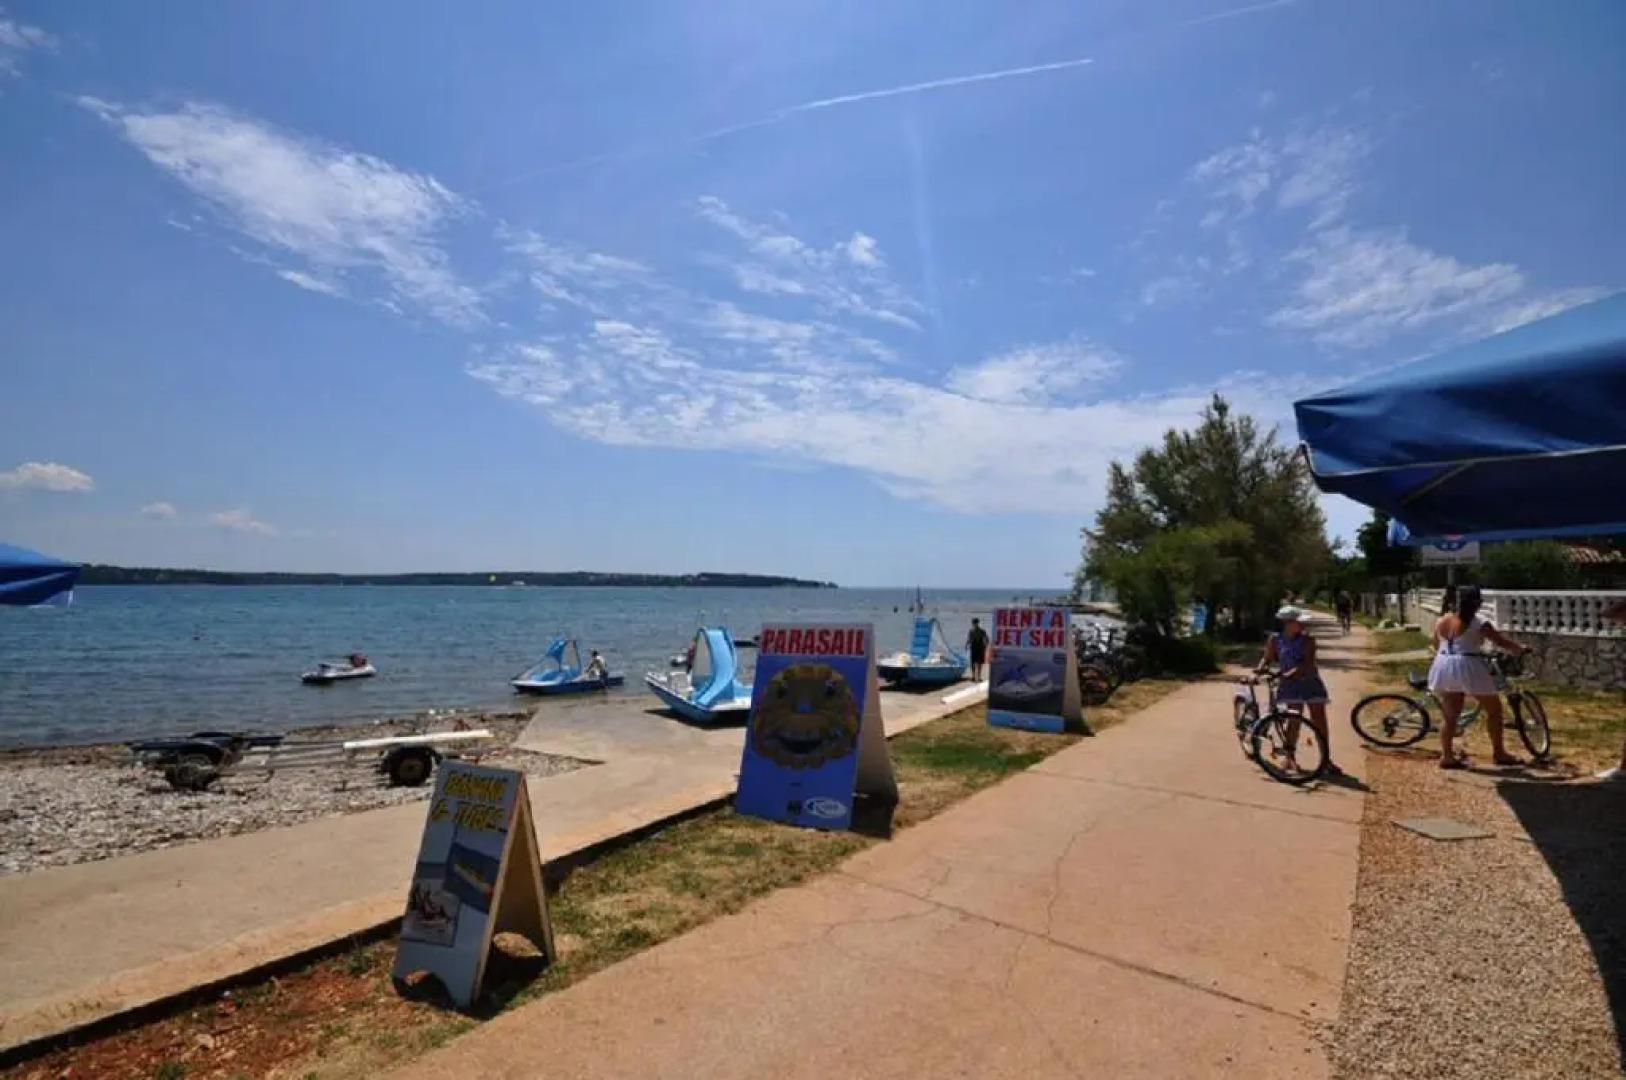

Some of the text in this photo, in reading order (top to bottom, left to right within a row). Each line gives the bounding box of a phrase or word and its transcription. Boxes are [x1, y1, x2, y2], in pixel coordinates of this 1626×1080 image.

[1050, 609, 1064, 628] A
[762, 628, 865, 655] PARASAIL
[996, 629, 1065, 648] JET SKI
